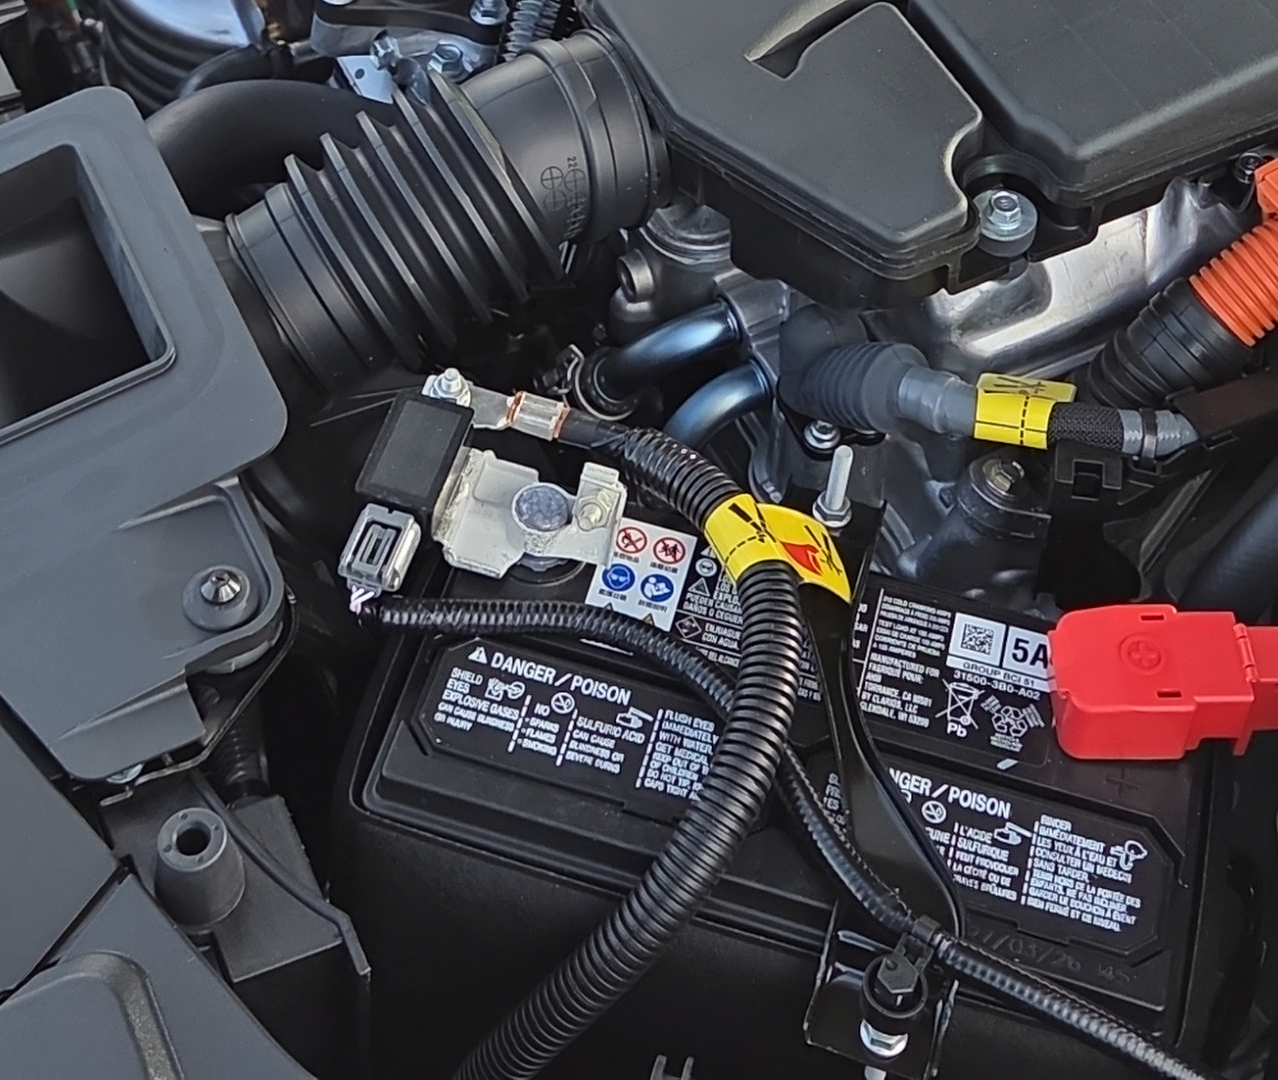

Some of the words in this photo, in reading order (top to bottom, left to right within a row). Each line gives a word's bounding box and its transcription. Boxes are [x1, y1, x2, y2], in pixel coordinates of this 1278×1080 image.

[685, 593, 715, 608] PUEDEN
[450, 667, 483, 686] SHIELD
[962, 661, 1001, 680] GROUP
[1002, 672, 1022, 684] BCI
[1023, 678, 1035, 688] 51
[446, 679, 470, 695] EYES
[902, 691, 912, 702] CA
[442, 689, 491, 715] EXPLOSIVE
[490, 702, 520, 721] GASES
[533, 702, 551, 718] NO
[577, 715, 622, 738] SULFURIC
[621, 728, 645, 745] ACID
[688, 716, 715, 732] EYES
[947, 722, 967, 738] Pb
[525, 727, 557, 745] FLAMES
[572, 728, 590, 742] CAN
[590, 732, 616, 749] CAUSE
[659, 731, 682, 748] WITH
[610, 751, 624, 763] OR
[654, 742, 673, 756] GET
[649, 762, 662, 774] OF
[672, 758, 689, 771] OUT
[689, 762, 700, 773] OF
